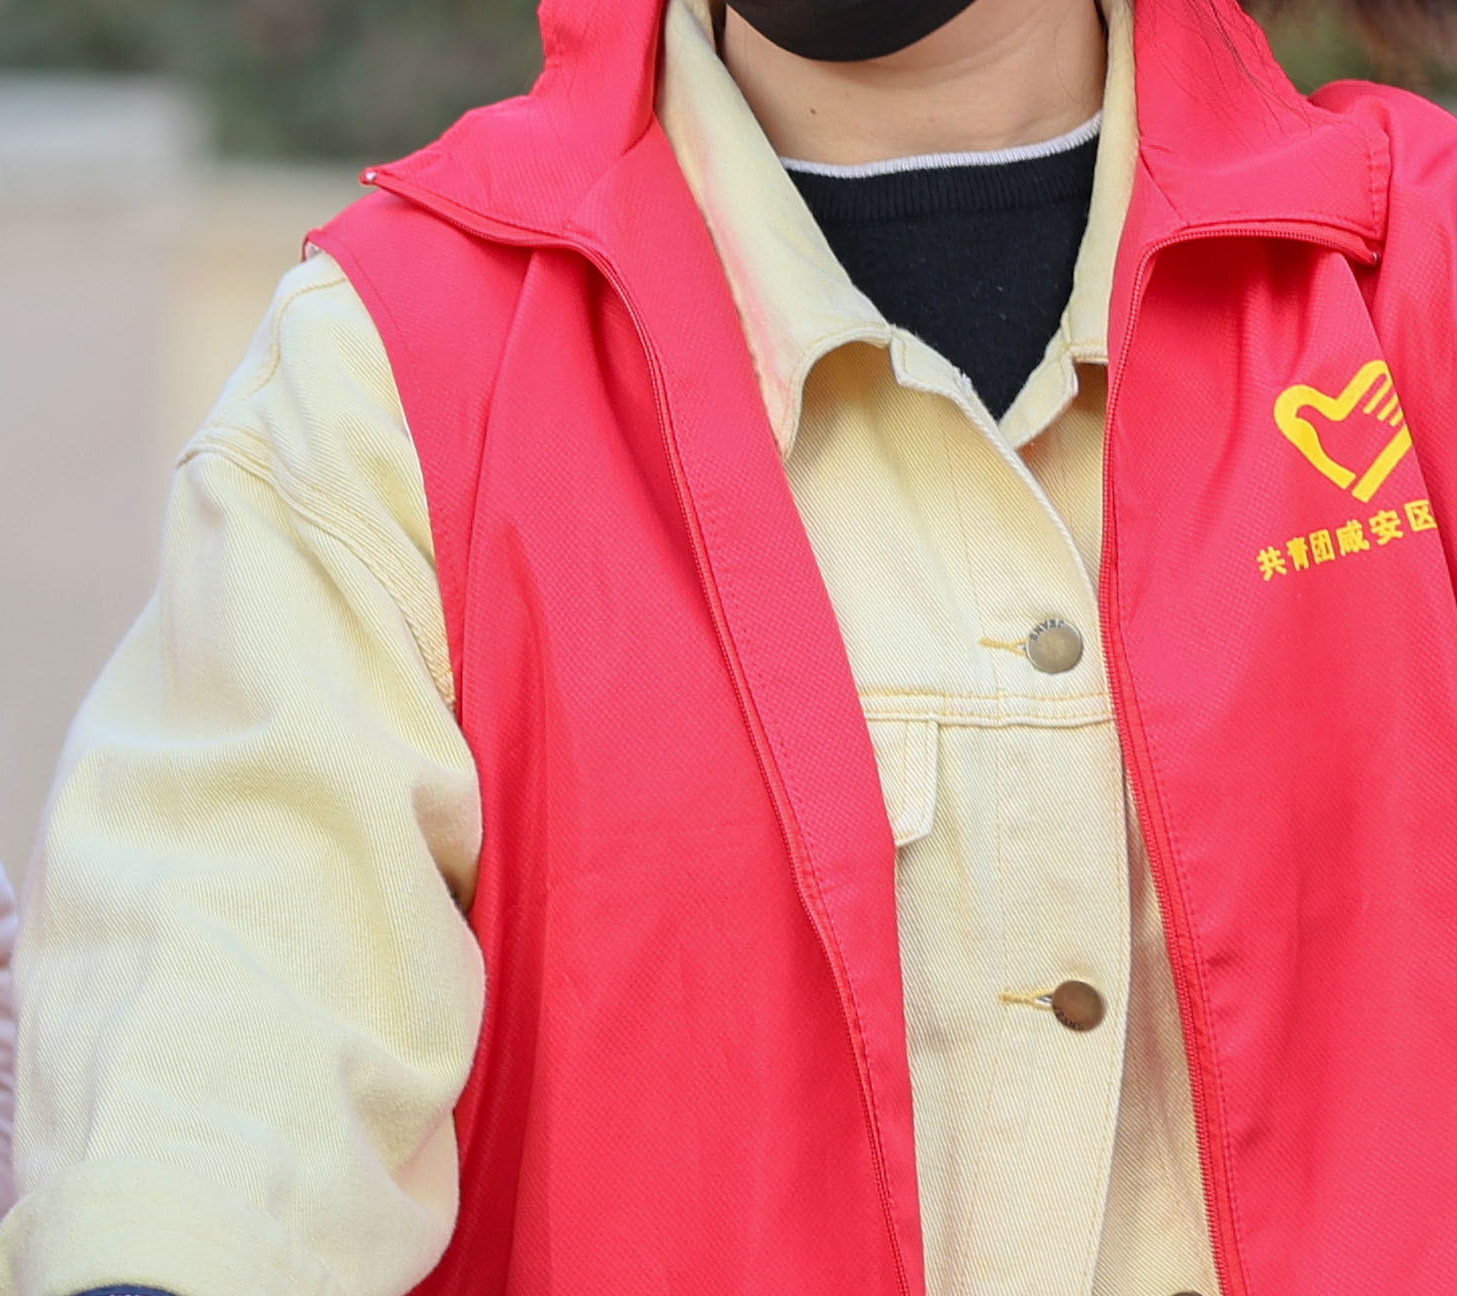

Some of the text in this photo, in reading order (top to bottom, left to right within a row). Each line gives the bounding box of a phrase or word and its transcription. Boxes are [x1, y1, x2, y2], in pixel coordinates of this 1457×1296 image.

[1256, 499, 1438, 582] 共青团咸安区
